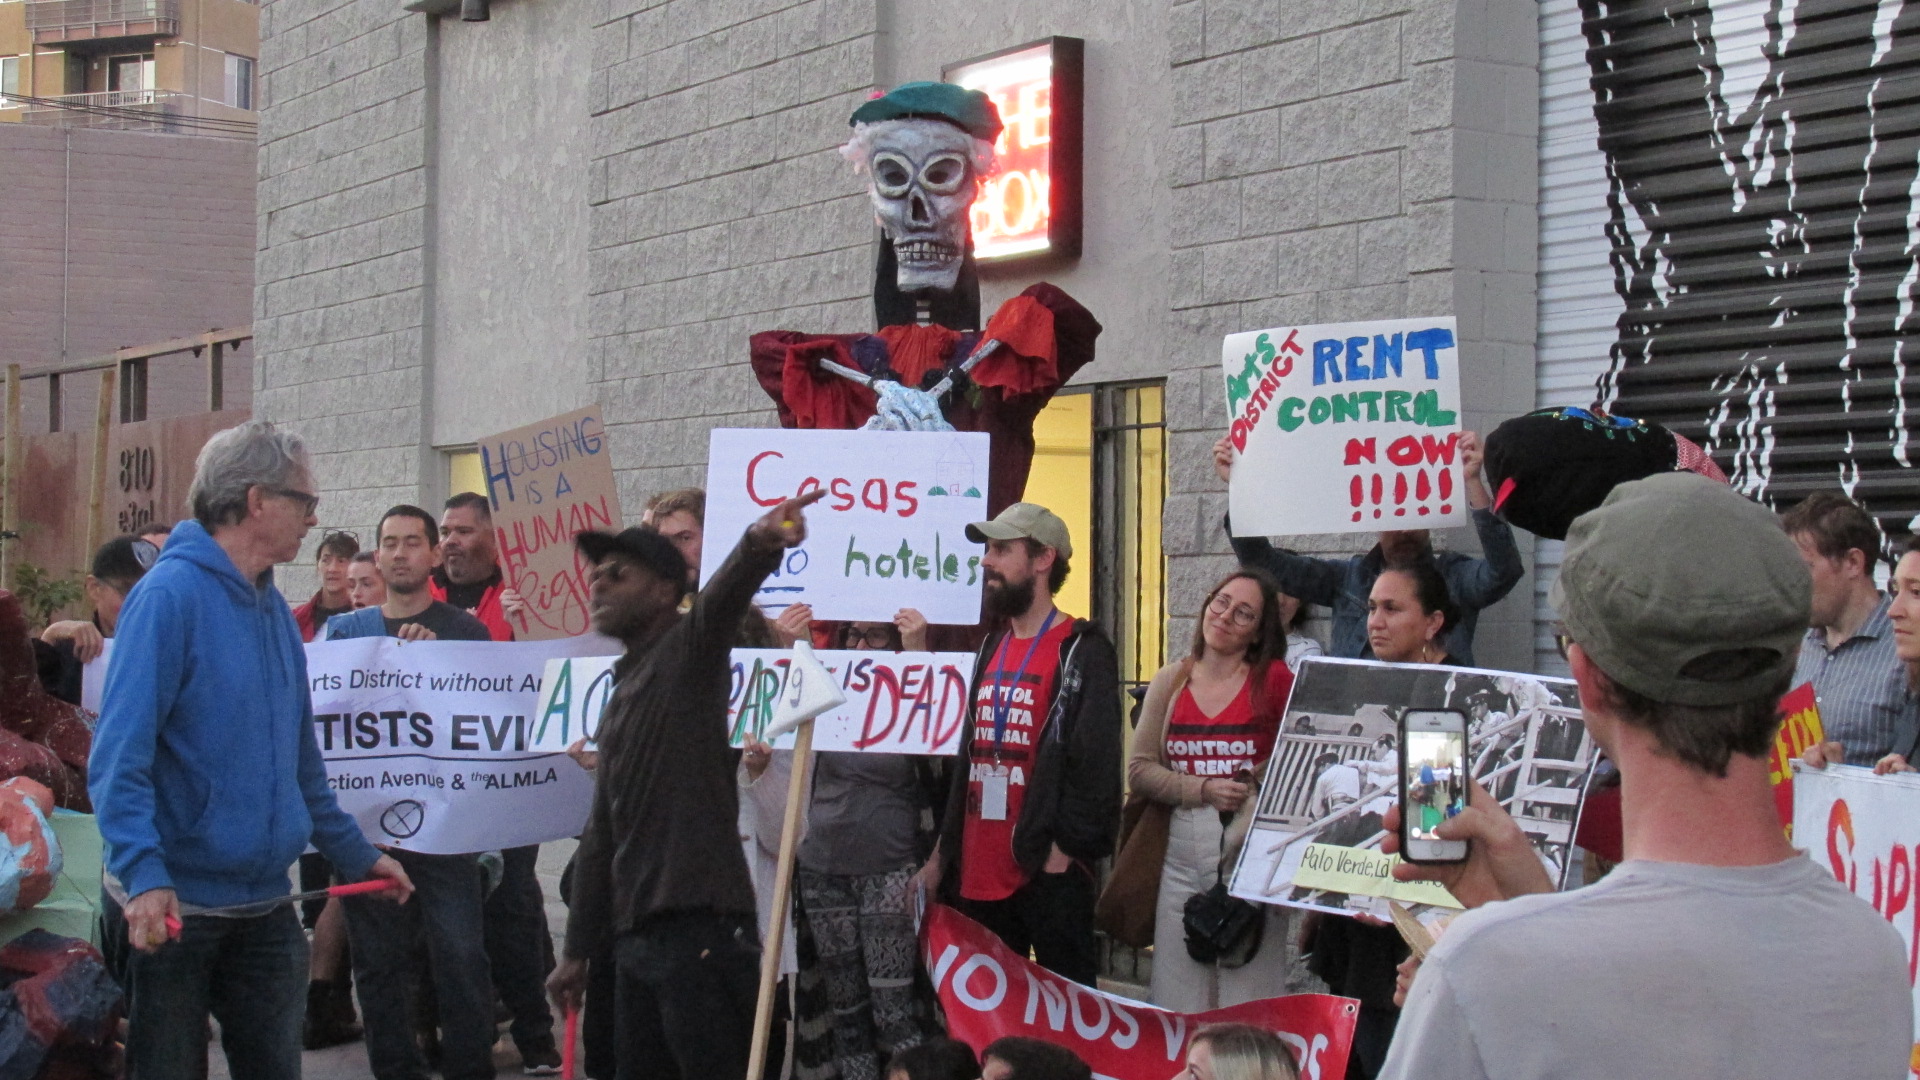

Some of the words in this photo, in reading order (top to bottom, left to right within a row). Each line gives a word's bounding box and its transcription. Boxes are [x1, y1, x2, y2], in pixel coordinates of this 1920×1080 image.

[1312, 328, 1455, 386] RENT
[119, 446, 154, 493] 810
[482, 416, 602, 512] HOUSING
[1343, 432, 1459, 467] NOW
[525, 479, 543, 505] IS
[555, 471, 573, 499] A
[497, 494, 612, 569] HUMAN
[844, 530, 981, 587] hoteles
[311, 670, 342, 692] rts
[349, 668, 422, 691] District
[429, 671, 514, 693] without
[842, 658, 874, 693] IS
[313, 709, 434, 752] TISTS
[450, 713, 535, 752] EVI
[852, 664, 968, 754] DEAD
[1166, 739, 1257, 757] CONTROL
[380, 770, 445, 790] Avenue
[450, 773, 466, 791] &
[1300, 845, 1334, 873] Palo
[1024, 967, 1140, 1050] NOS
